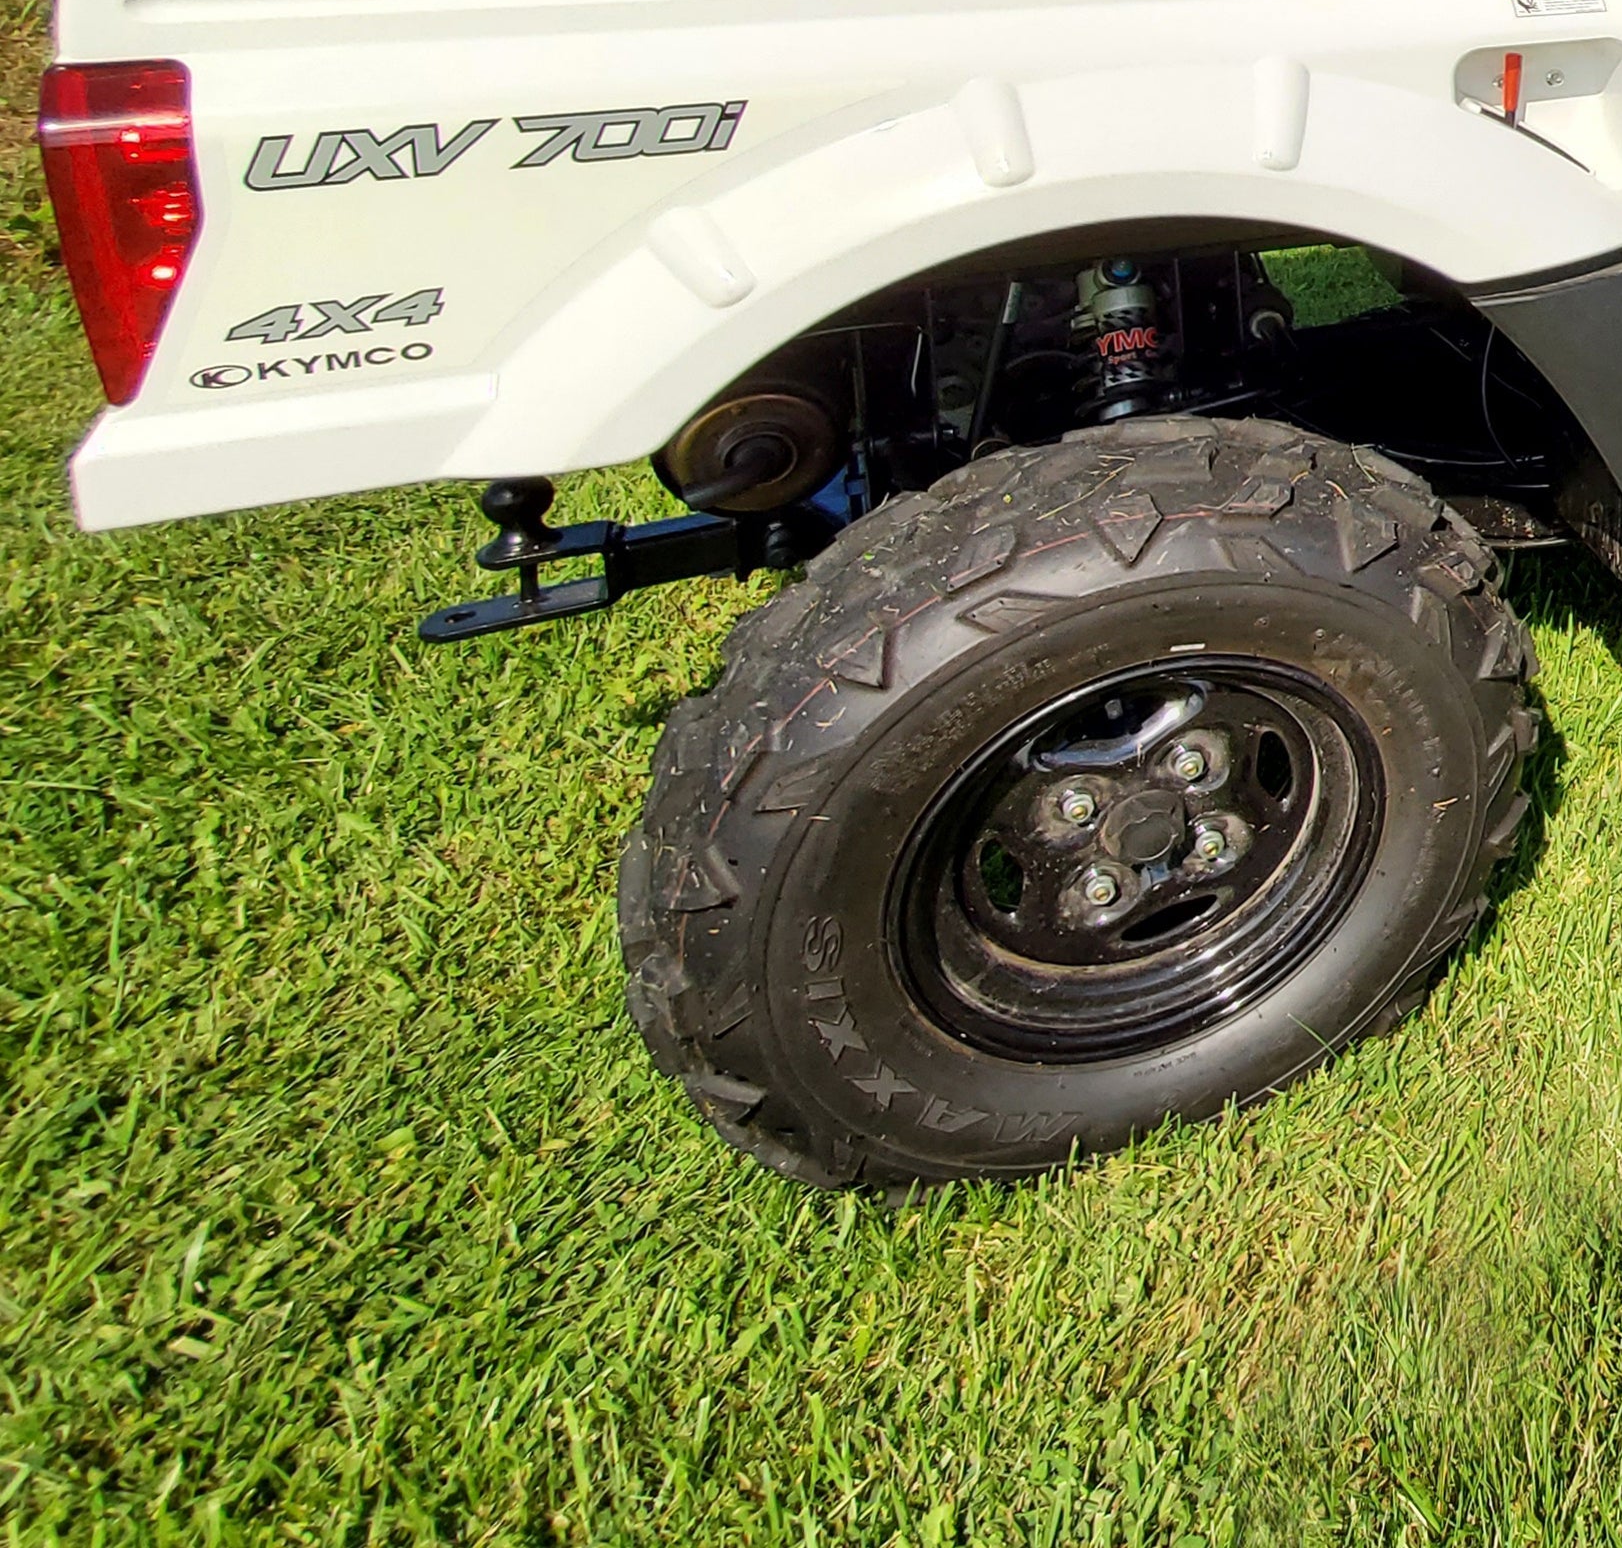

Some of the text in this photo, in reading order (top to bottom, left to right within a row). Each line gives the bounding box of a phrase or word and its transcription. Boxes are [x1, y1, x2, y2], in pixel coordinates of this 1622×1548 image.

[243, 100, 748, 192] UXV 700i
[257, 342, 433, 380] KYMCO
[1097, 327, 1158, 356] YMC
[803, 916, 1083, 1142] MAXXIS
